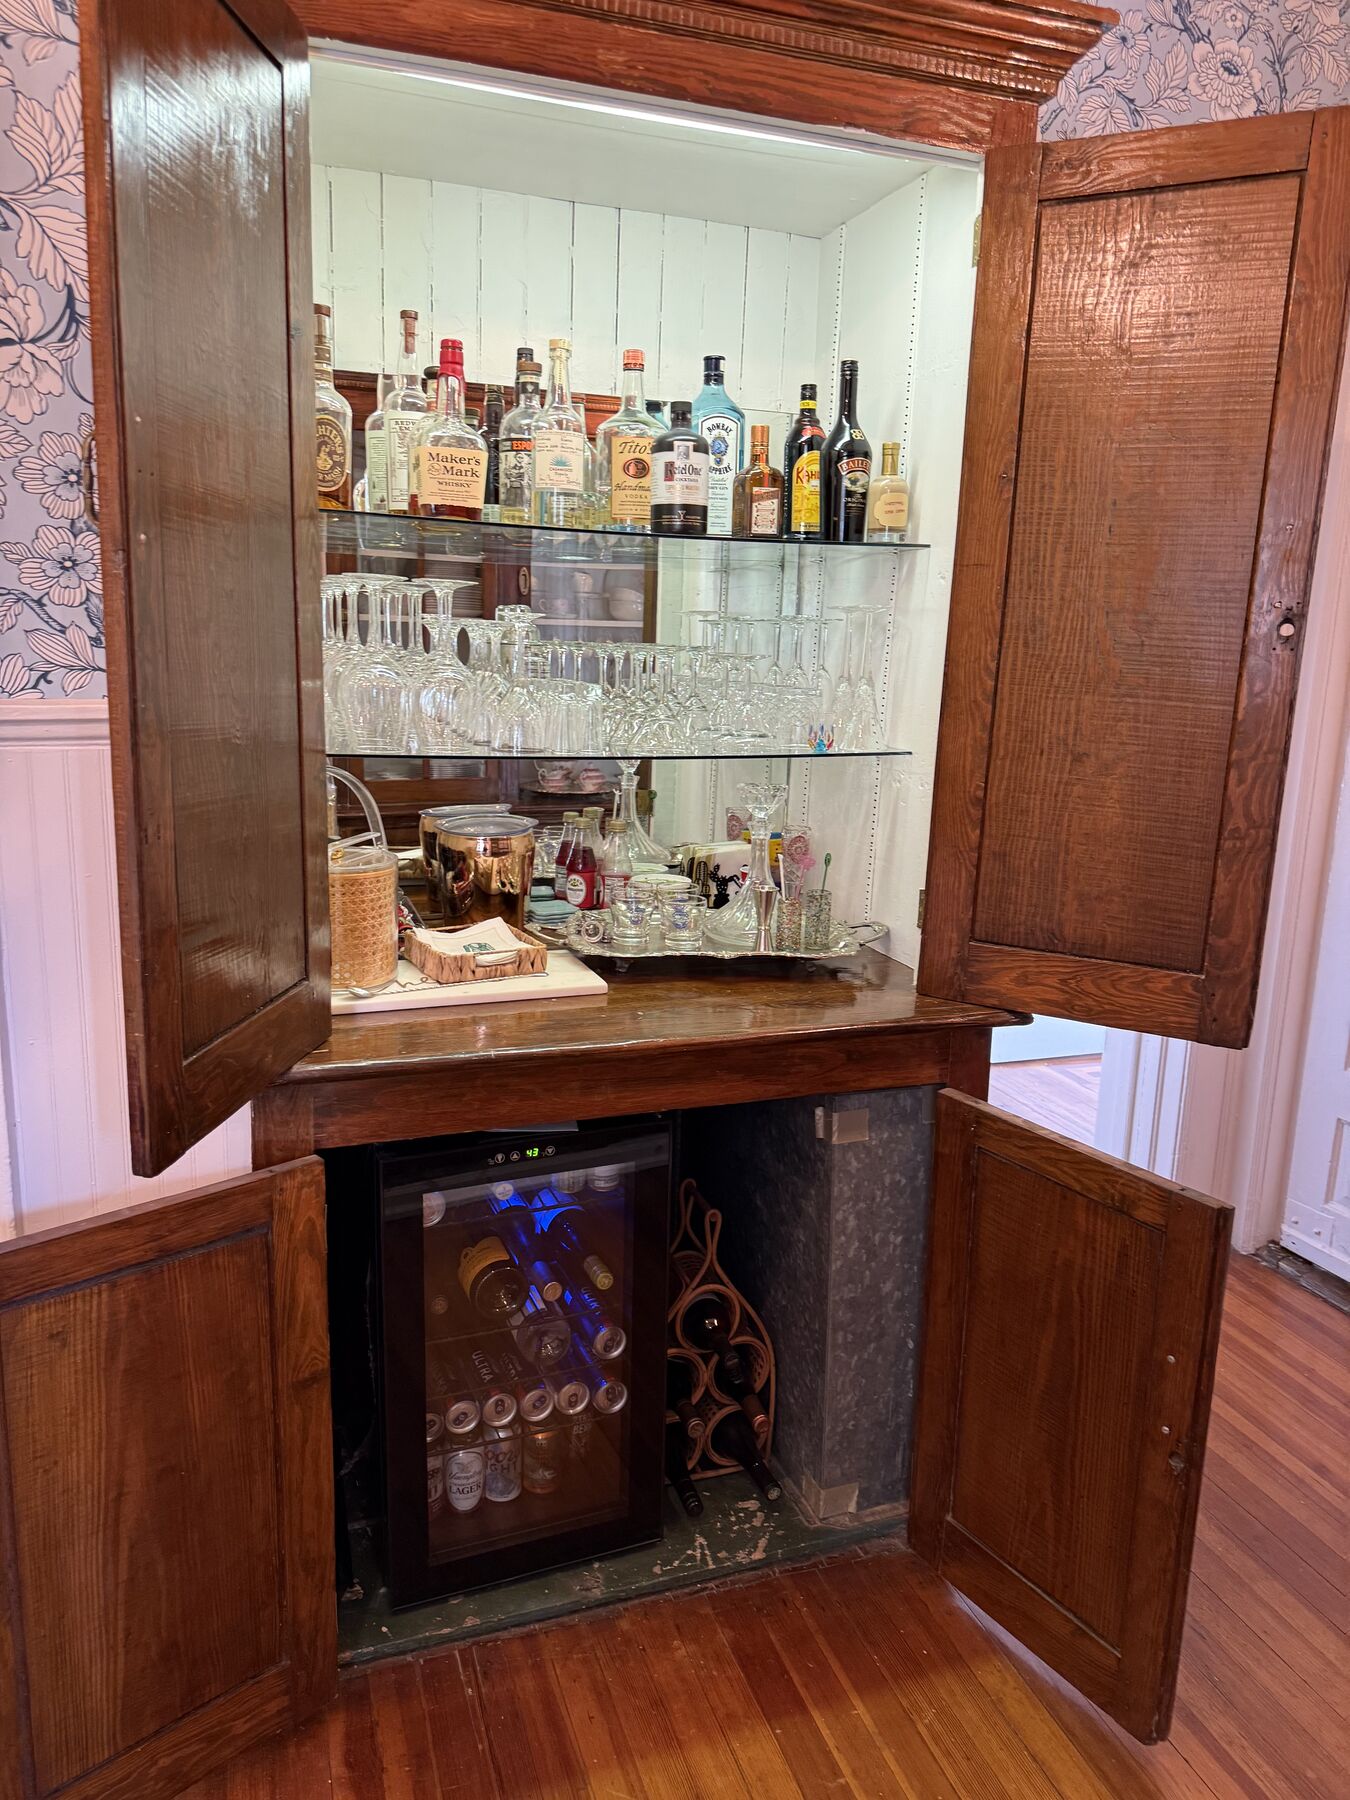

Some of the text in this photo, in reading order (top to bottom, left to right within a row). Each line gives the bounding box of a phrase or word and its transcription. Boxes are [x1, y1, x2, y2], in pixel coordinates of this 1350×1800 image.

[706, 422, 734, 434] BOMBAY
[427, 452, 480, 466] Maker's
[442, 465, 480, 478] Mark
[664, 460, 702, 482] Ketel One
[525, 1147, 540, 1157] 43
[471, 1349, 495, 1384] ULTRA
[448, 1480, 483, 1496] LAGER
